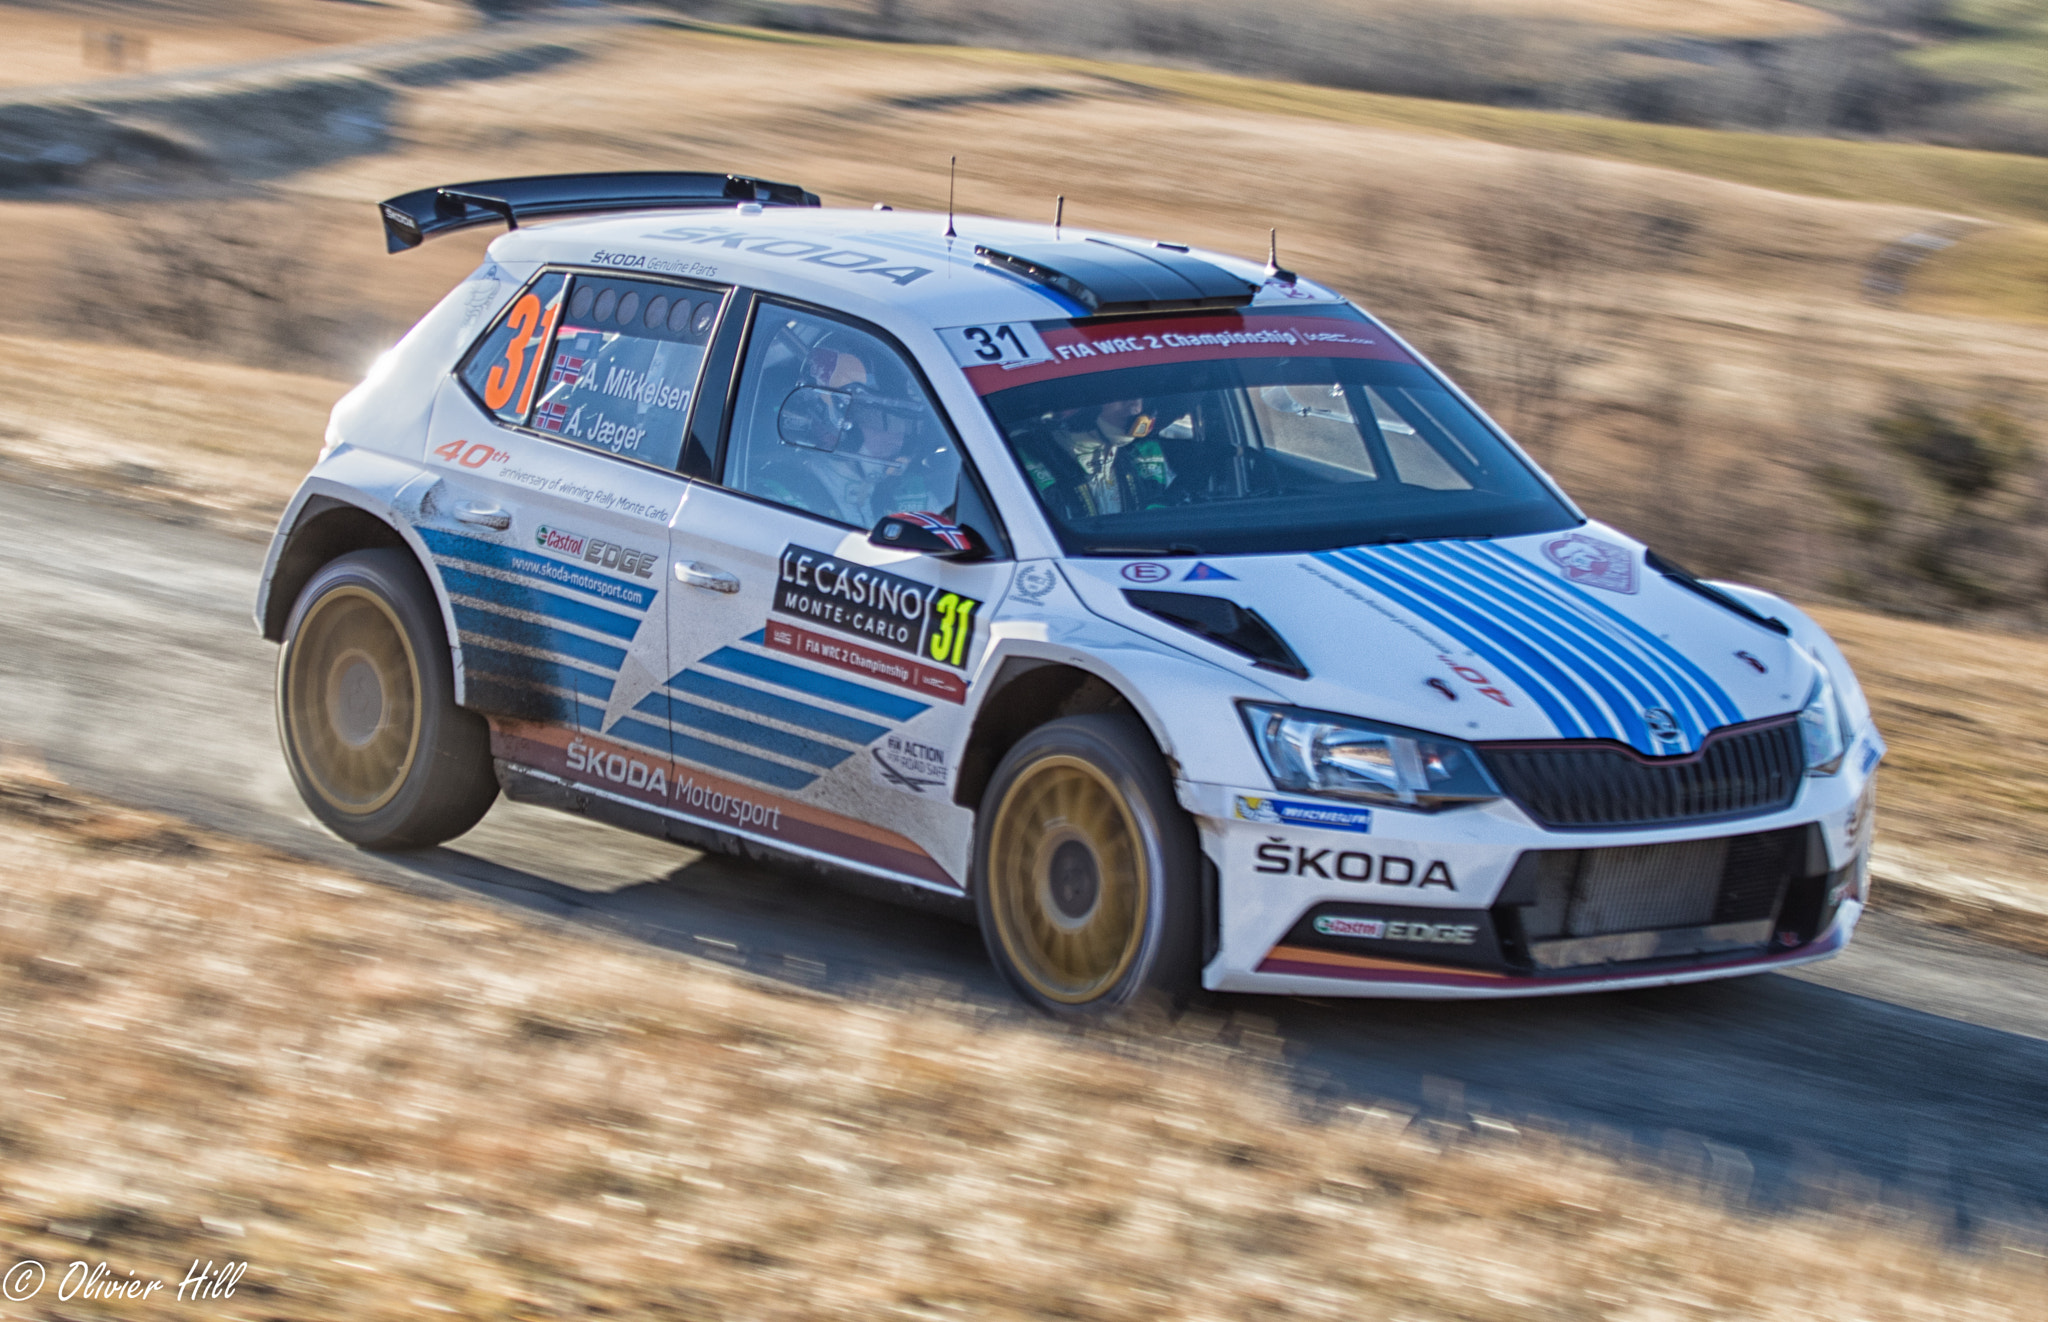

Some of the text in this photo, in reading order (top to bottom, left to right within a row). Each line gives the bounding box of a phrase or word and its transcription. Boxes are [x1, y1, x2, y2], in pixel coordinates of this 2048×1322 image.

[591, 250, 718, 277] ŠKODA Genuine Parts
[640, 226, 934, 286] ŠKODA
[484, 294, 562, 415] 31
[963, 325, 1030, 361] 31
[1055, 343, 1097, 360] FIA
[1092, 337, 1145, 355] WRC
[1143, 335, 1162, 350] 2
[1161, 330, 1297, 347] Championship
[580, 362, 690, 412] A. Mikkelsen
[434, 440, 510, 469] 40th
[587, 413, 646, 453] Jæger
[500, 468, 668, 521] anniversary of winning Rally Monte Carlo
[547, 530, 659, 579] Castrol EDGE
[511, 557, 643, 605] www.skoda-motorsport.com
[930, 593, 975, 666] 31
[805, 639, 909, 681] FIA WRC 2 Championship
[905, 741, 945, 765] ACTION
[566, 737, 782, 831] ŠKODA Motorsport
[1255, 836, 1457, 892] ŠKODA
[1384, 921, 1480, 945] EDGE
